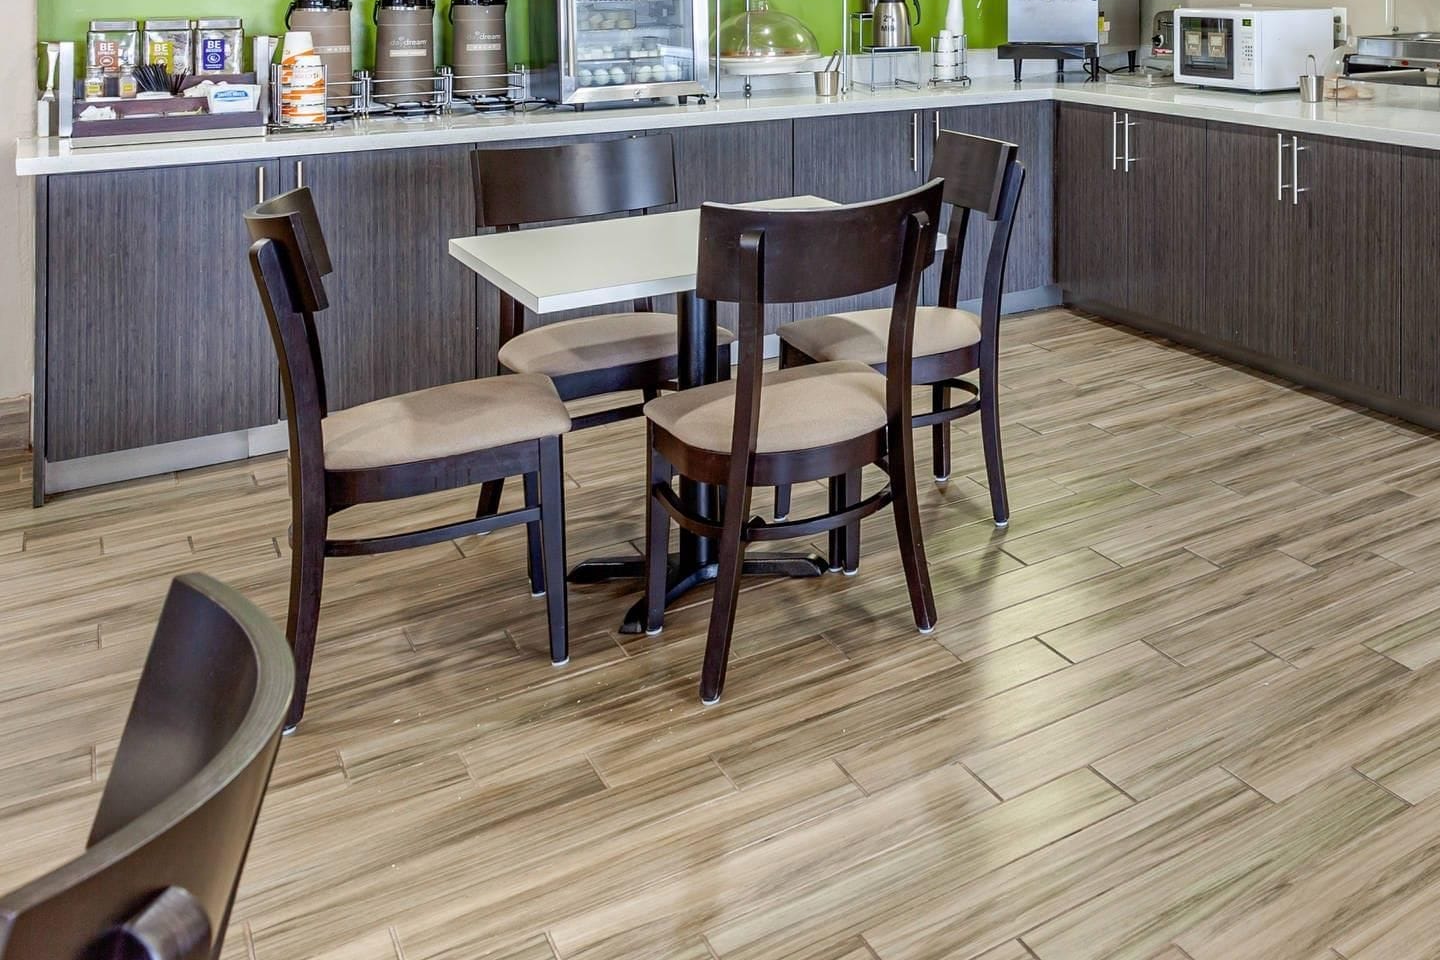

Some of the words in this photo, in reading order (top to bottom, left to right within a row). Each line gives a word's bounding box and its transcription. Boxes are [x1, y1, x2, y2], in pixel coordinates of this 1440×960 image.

[100, 42, 114, 52] BE
[154, 43, 168, 53] BE
[207, 40, 221, 49] BE
